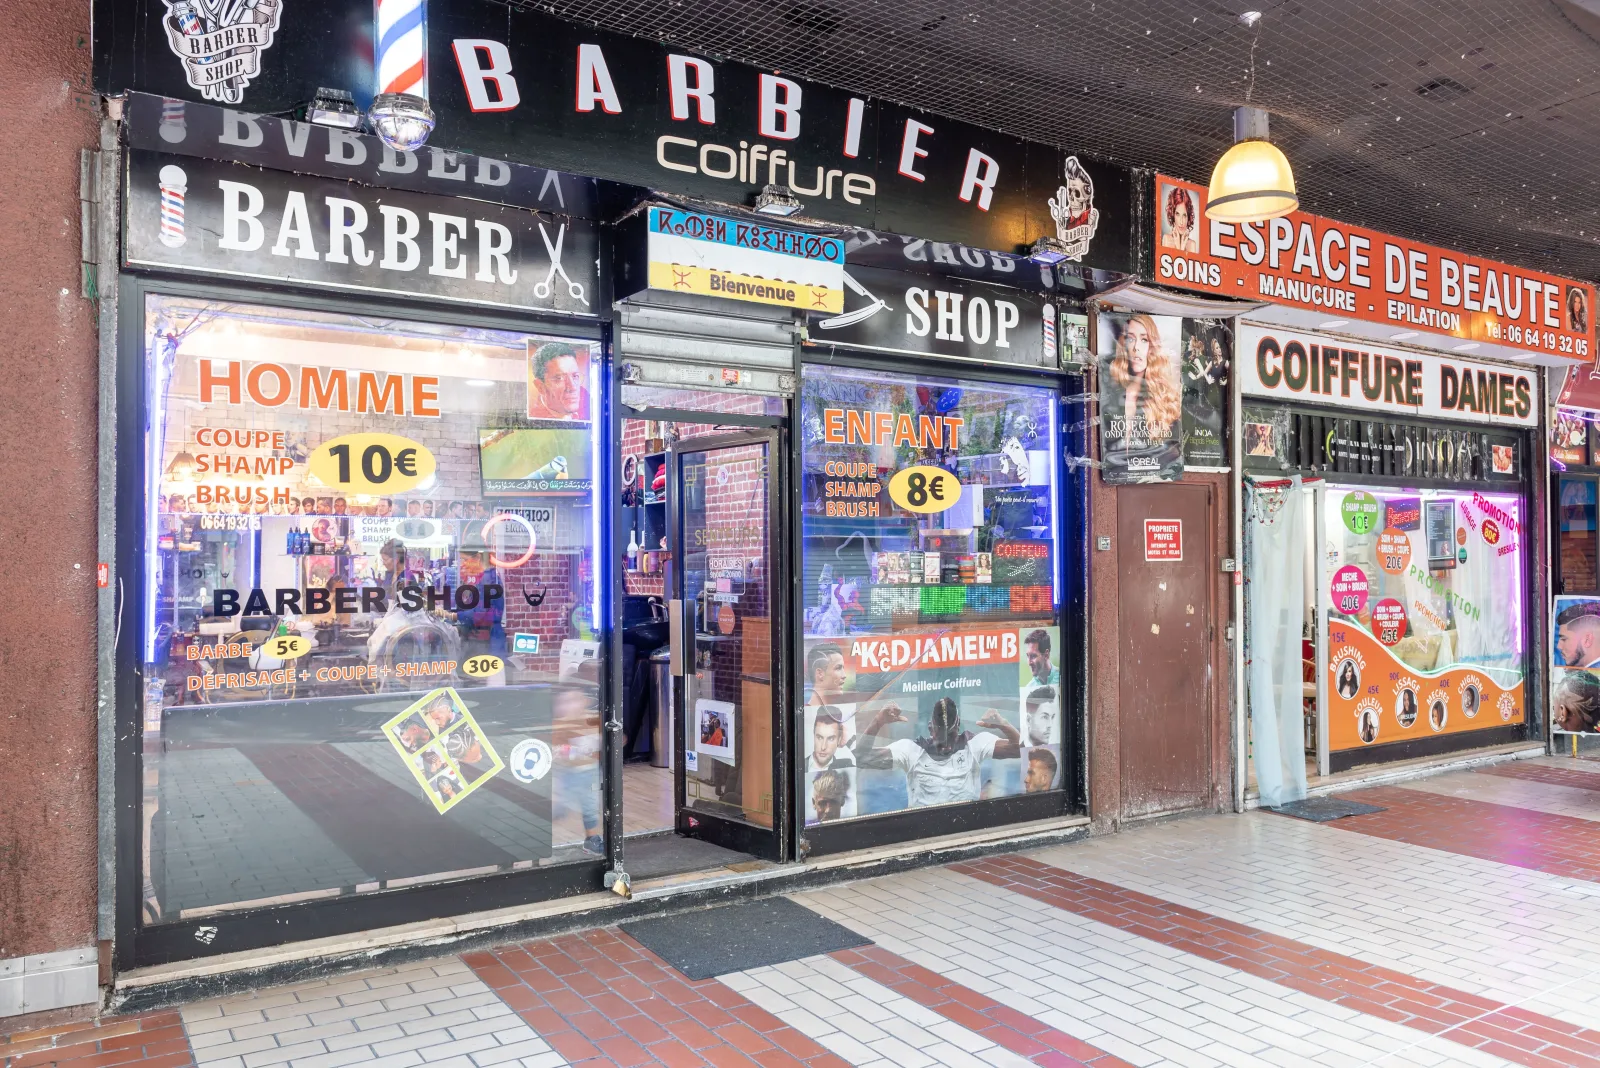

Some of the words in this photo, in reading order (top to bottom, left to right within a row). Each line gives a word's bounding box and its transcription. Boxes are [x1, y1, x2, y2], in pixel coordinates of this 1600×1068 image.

[189, 27, 258, 54] BARBER
[205, 59, 243, 81] SHOP
[451, 38, 1000, 212] BARBIER
[218, 179, 518, 285] BARBER
[1209, 217, 1371, 288] ESPACE
[1384, 242, 1429, 300] DE
[1440, 258, 1560, 328] BEAUTE
[710, 273, 796, 302] Bienvenue
[1160, 254, 1221, 287] SOINS
[1258, 274, 1356, 312] MANUCURE
[1387, 300, 1460, 331] EPILATION
[905, 286, 1020, 348] SHOP
[1508, 325, 1522, 344] 06
[1524, 328, 1539, 347] 64
[1542, 331, 1555, 350] 19
[1558, 333, 1573, 353] 32
[1575, 336, 1588, 356] 05
[199, 358, 441, 418] HOMME
[1257, 335, 1423, 407] COIFFURE
[1441, 365, 1532, 420] DAMES
[196, 428, 285, 450] COUPE
[824, 408, 964, 450] ENFANT
[195, 453, 294, 476] SHAMP
[329, 444, 417, 483] 10€
[825, 460, 877, 478] COUPE
[196, 485, 290, 505] BRUSH
[825, 481, 881, 498] SHAMP
[906, 472, 945, 506] 8€
[825, 501, 880, 517] BRUSH
[1460, 501, 1477, 531] LISSAGE
[1472, 492, 1520, 535] PROMOTION
[1352, 515, 1368, 529] 10€
[1484, 527, 1497, 543] 80€
[996, 544, 1048, 557] COIFFEUR
[709, 559, 742, 568] HORAIRES
[1386, 556, 1402, 569] 20€
[213, 586, 389, 616] BARBER
[401, 585, 503, 611] SHOP
[1341, 596, 1359, 610] 40€
[1410, 564, 1480, 621] PROMOTION
[1415, 600, 1446, 631] PROMOTION
[1332, 632, 1345, 643] 15€
[1381, 629, 1398, 643] 45€
[187, 643, 252, 660] BARBE
[276, 640, 298, 655] 5€
[1329, 645, 1367, 672] BRUSHING
[187, 668, 296, 691] DÉFRISAGE
[316, 665, 377, 681] COUPE
[395, 660, 457, 676] SHAMP
[468, 659, 498, 673] 30€
[903, 681, 942, 693] Meilleur
[944, 677, 982, 690] Coiffure
[1392, 676, 1421, 695] LISSAGE
[1458, 674, 1483, 694] CHIGNON
[1353, 697, 1383, 718] COULEUR
[1426, 689, 1449, 705] MECHES
